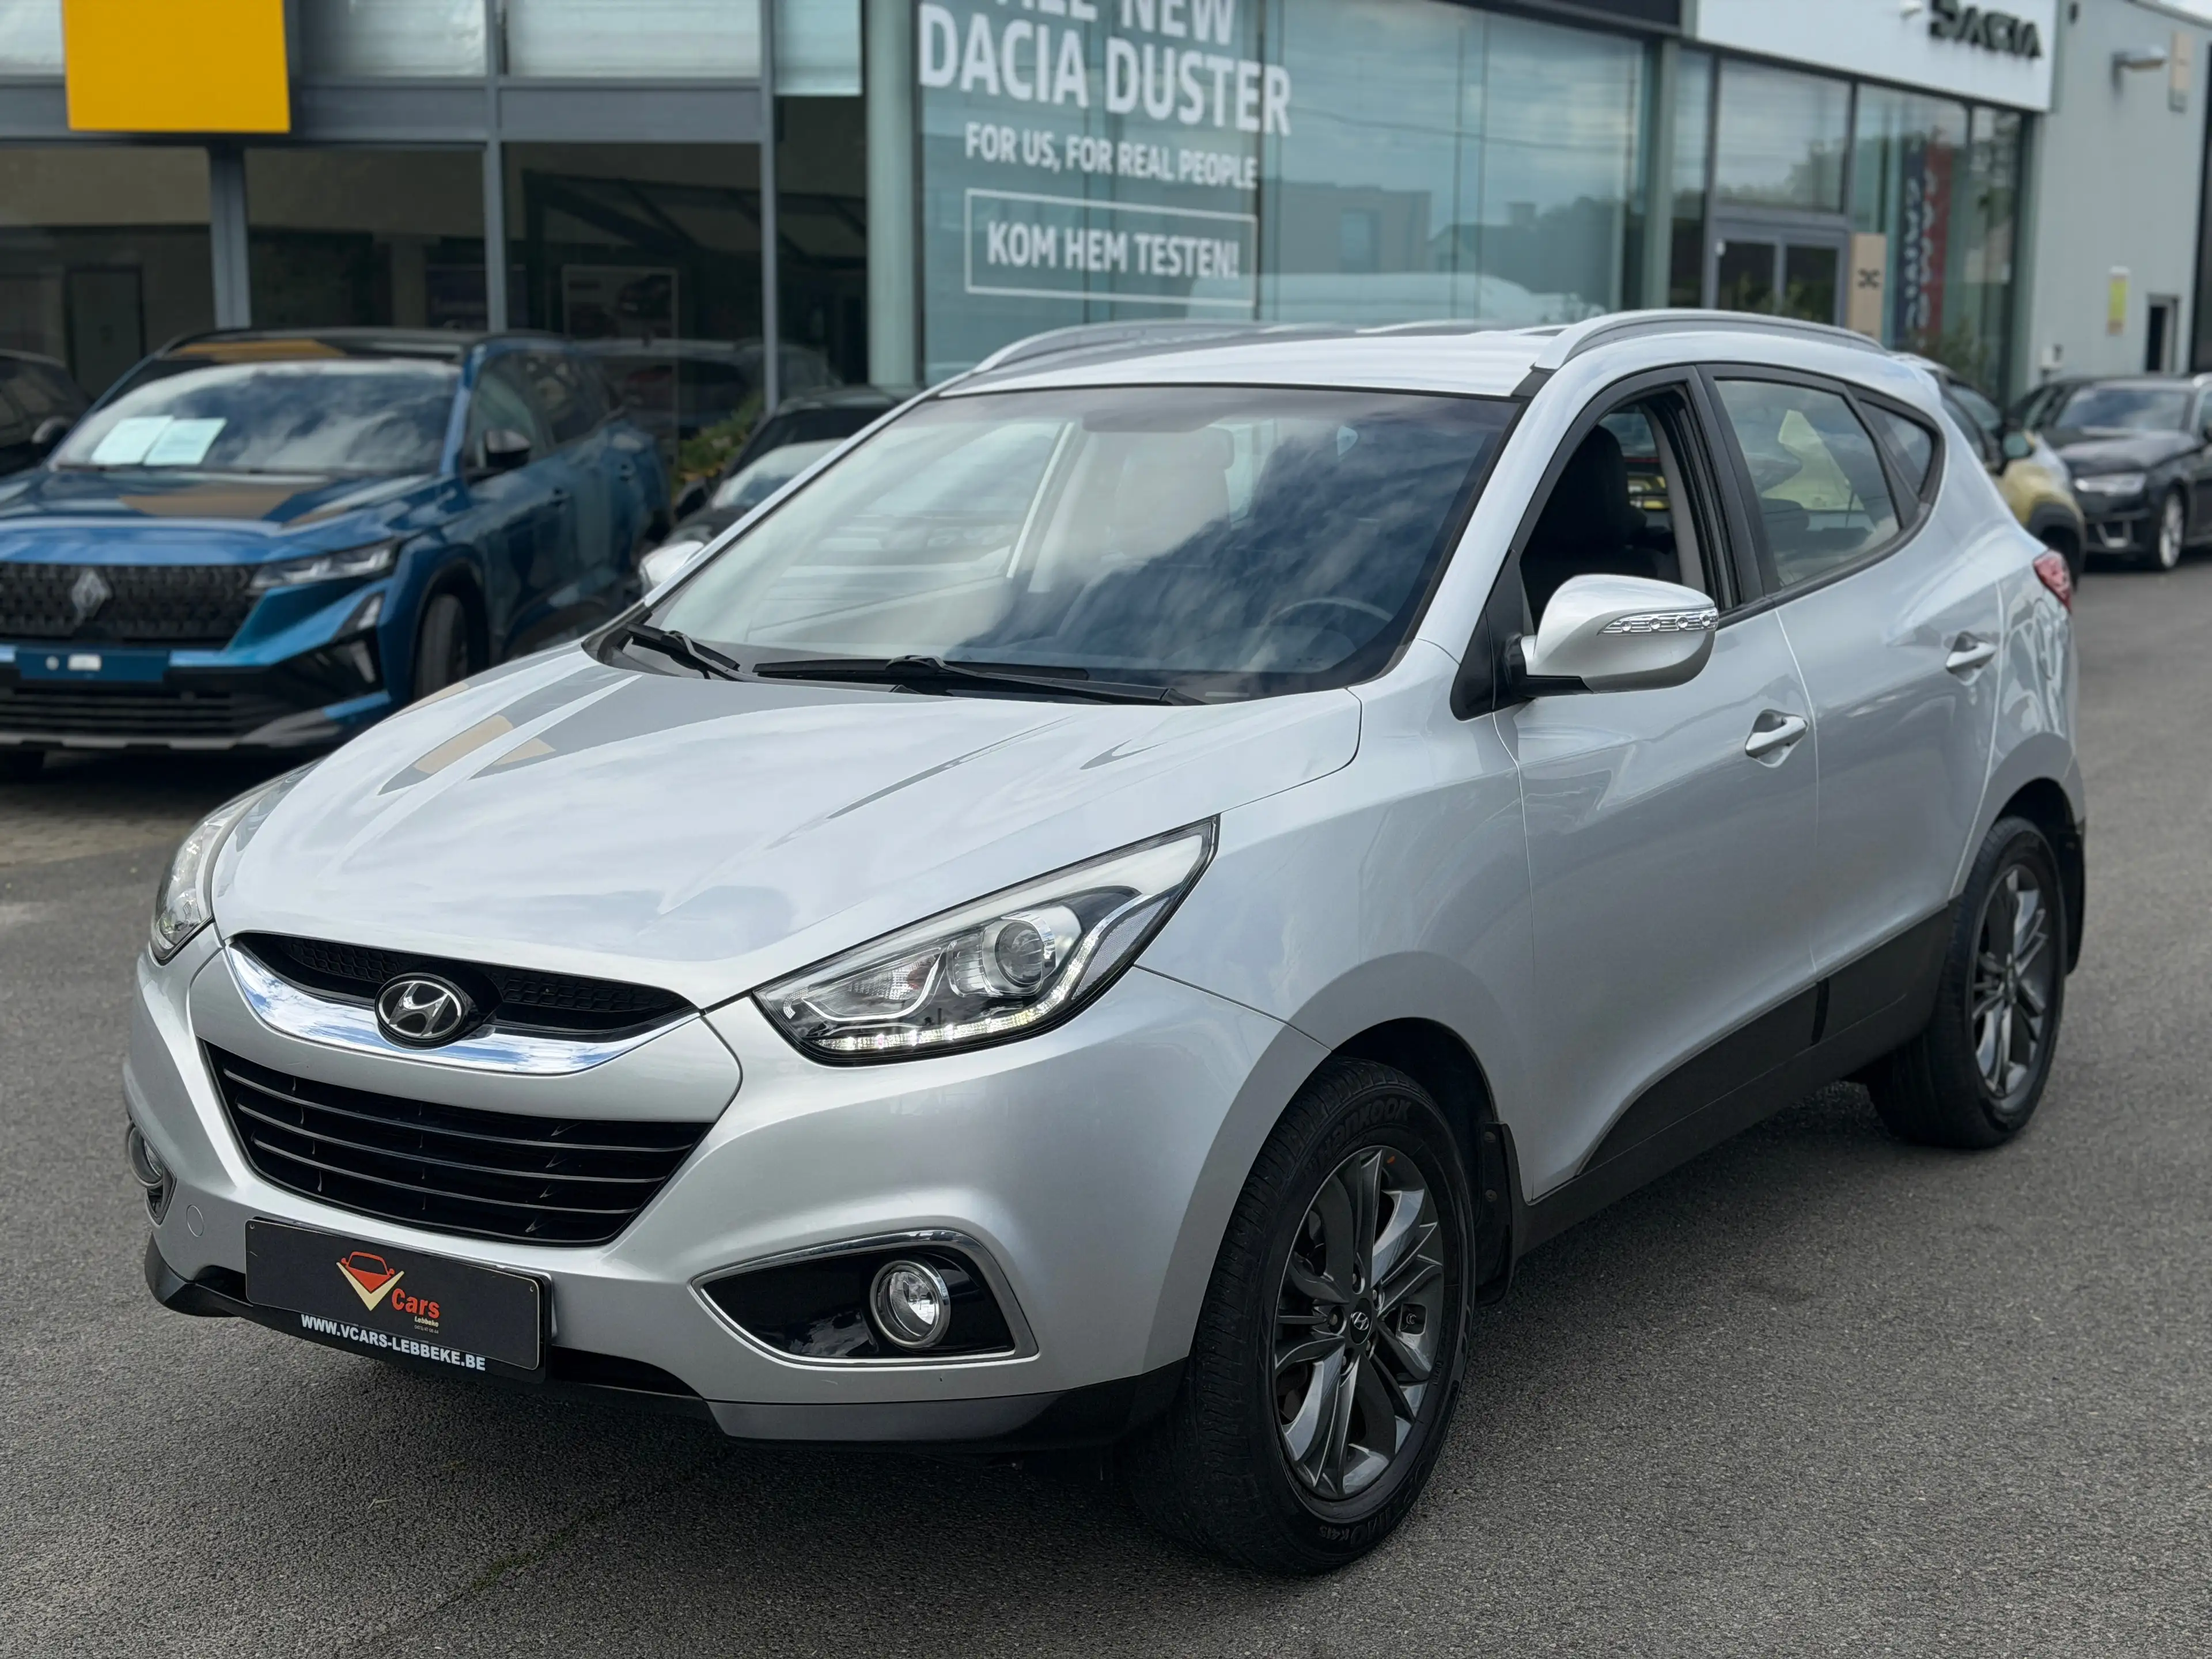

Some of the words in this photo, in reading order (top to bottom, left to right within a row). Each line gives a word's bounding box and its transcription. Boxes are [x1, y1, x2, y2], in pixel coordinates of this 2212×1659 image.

[919, 5, 1088, 107] DACIA
[1107, 37, 1291, 135] DUSTER
[966, 123, 1016, 161] FOR
[1022, 131, 1060, 173] US,
[1066, 136, 1112, 173] FOR
[1118, 143, 1175, 181] REAL
[1179, 150, 1258, 190] PEOPLE
[987, 222, 1056, 268] KOM
[1065, 228, 1127, 272] HEM
[1134, 233, 1240, 280] TESTEN!
[392, 1289, 440, 1319] Cars
[414, 1316, 439, 1327] Lebbeke
[301, 1314, 486, 1371] WWW.VCARS-LEBBEKE.BE
